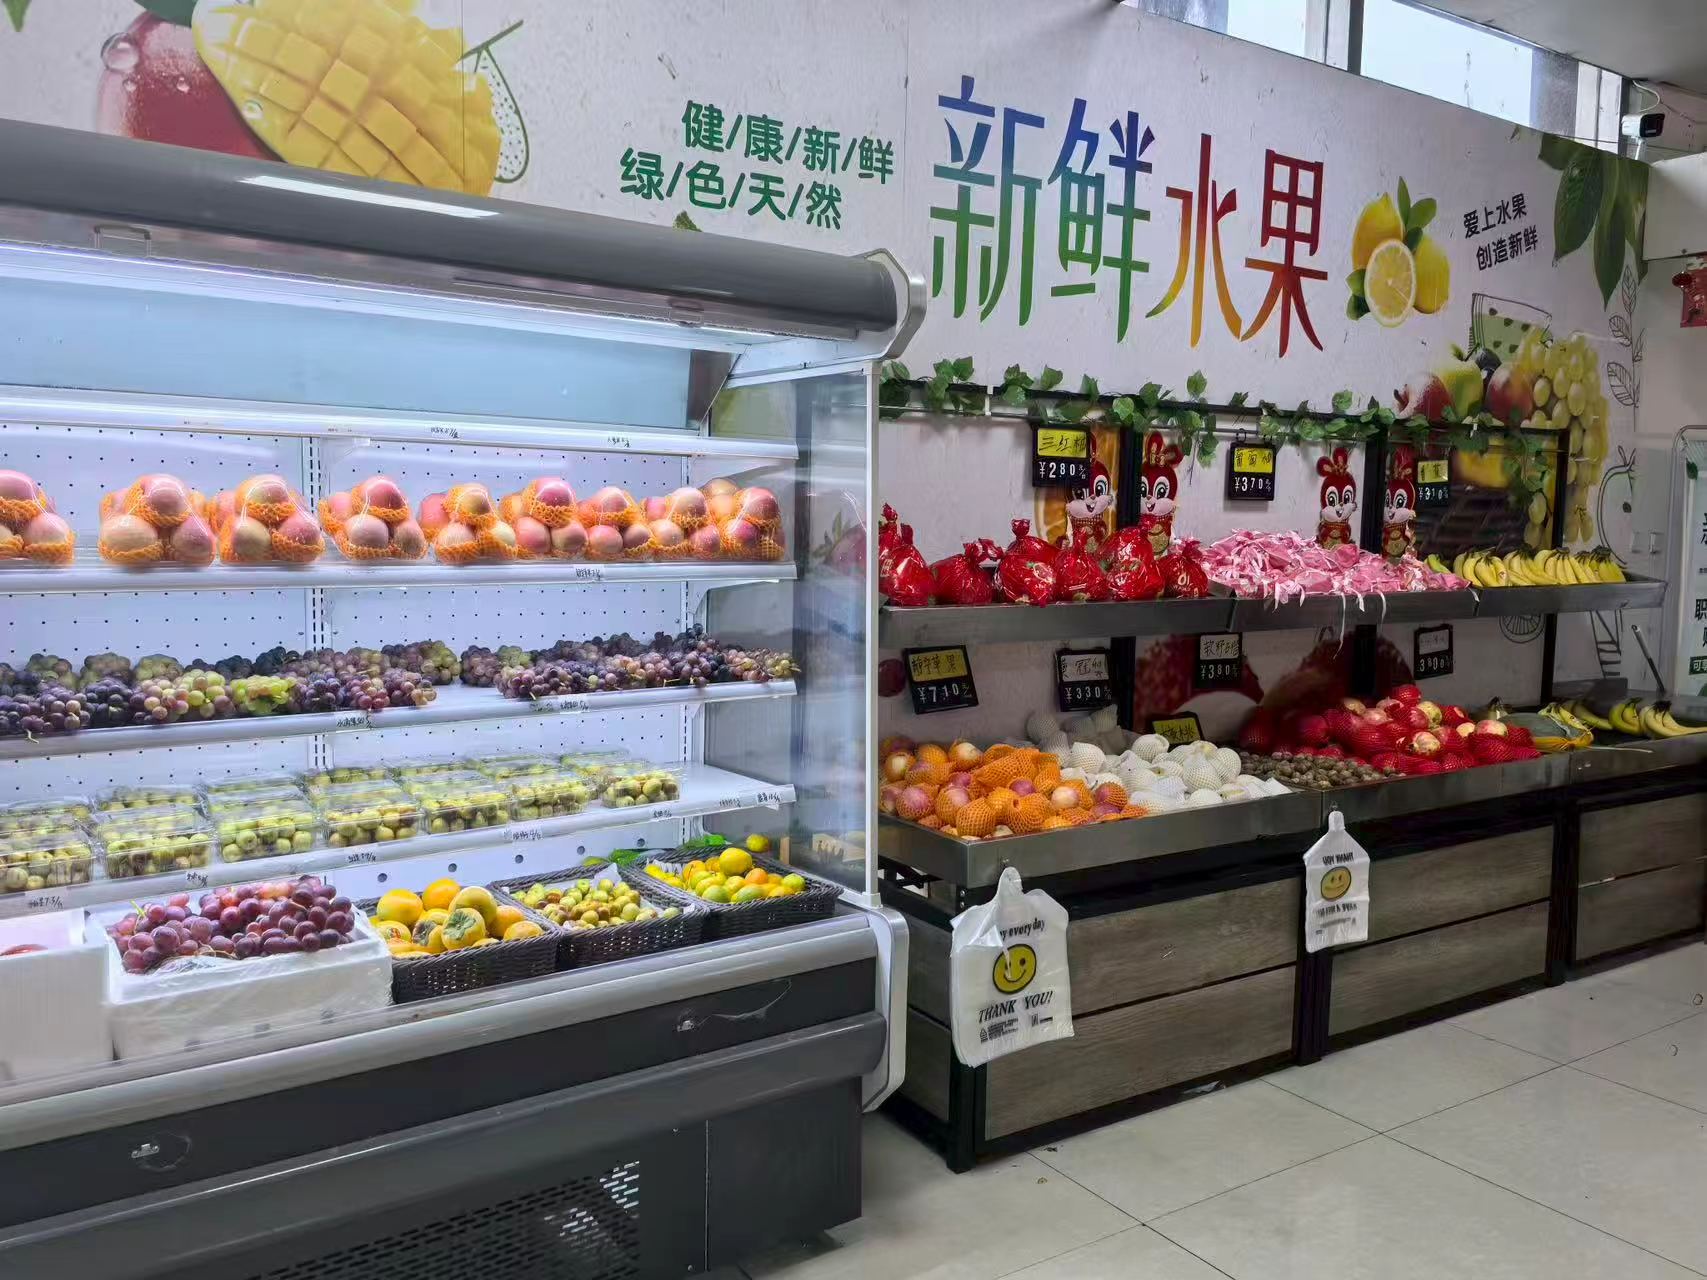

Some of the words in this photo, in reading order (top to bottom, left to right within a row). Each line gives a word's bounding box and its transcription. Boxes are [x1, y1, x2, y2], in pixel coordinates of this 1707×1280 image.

[681, 100, 895, 184] 健/康/新/鲜
[619, 147, 842, 230] 绿/色/天/然
[930, 75, 1328, 358] 新鲜水果
[1463, 193, 1527, 239] 爱上水果
[1476, 225, 1539, 271] 创造新鲜
[978, 999, 1017, 1024] THANK
[1024, 991, 1054, 1011] YOU!
